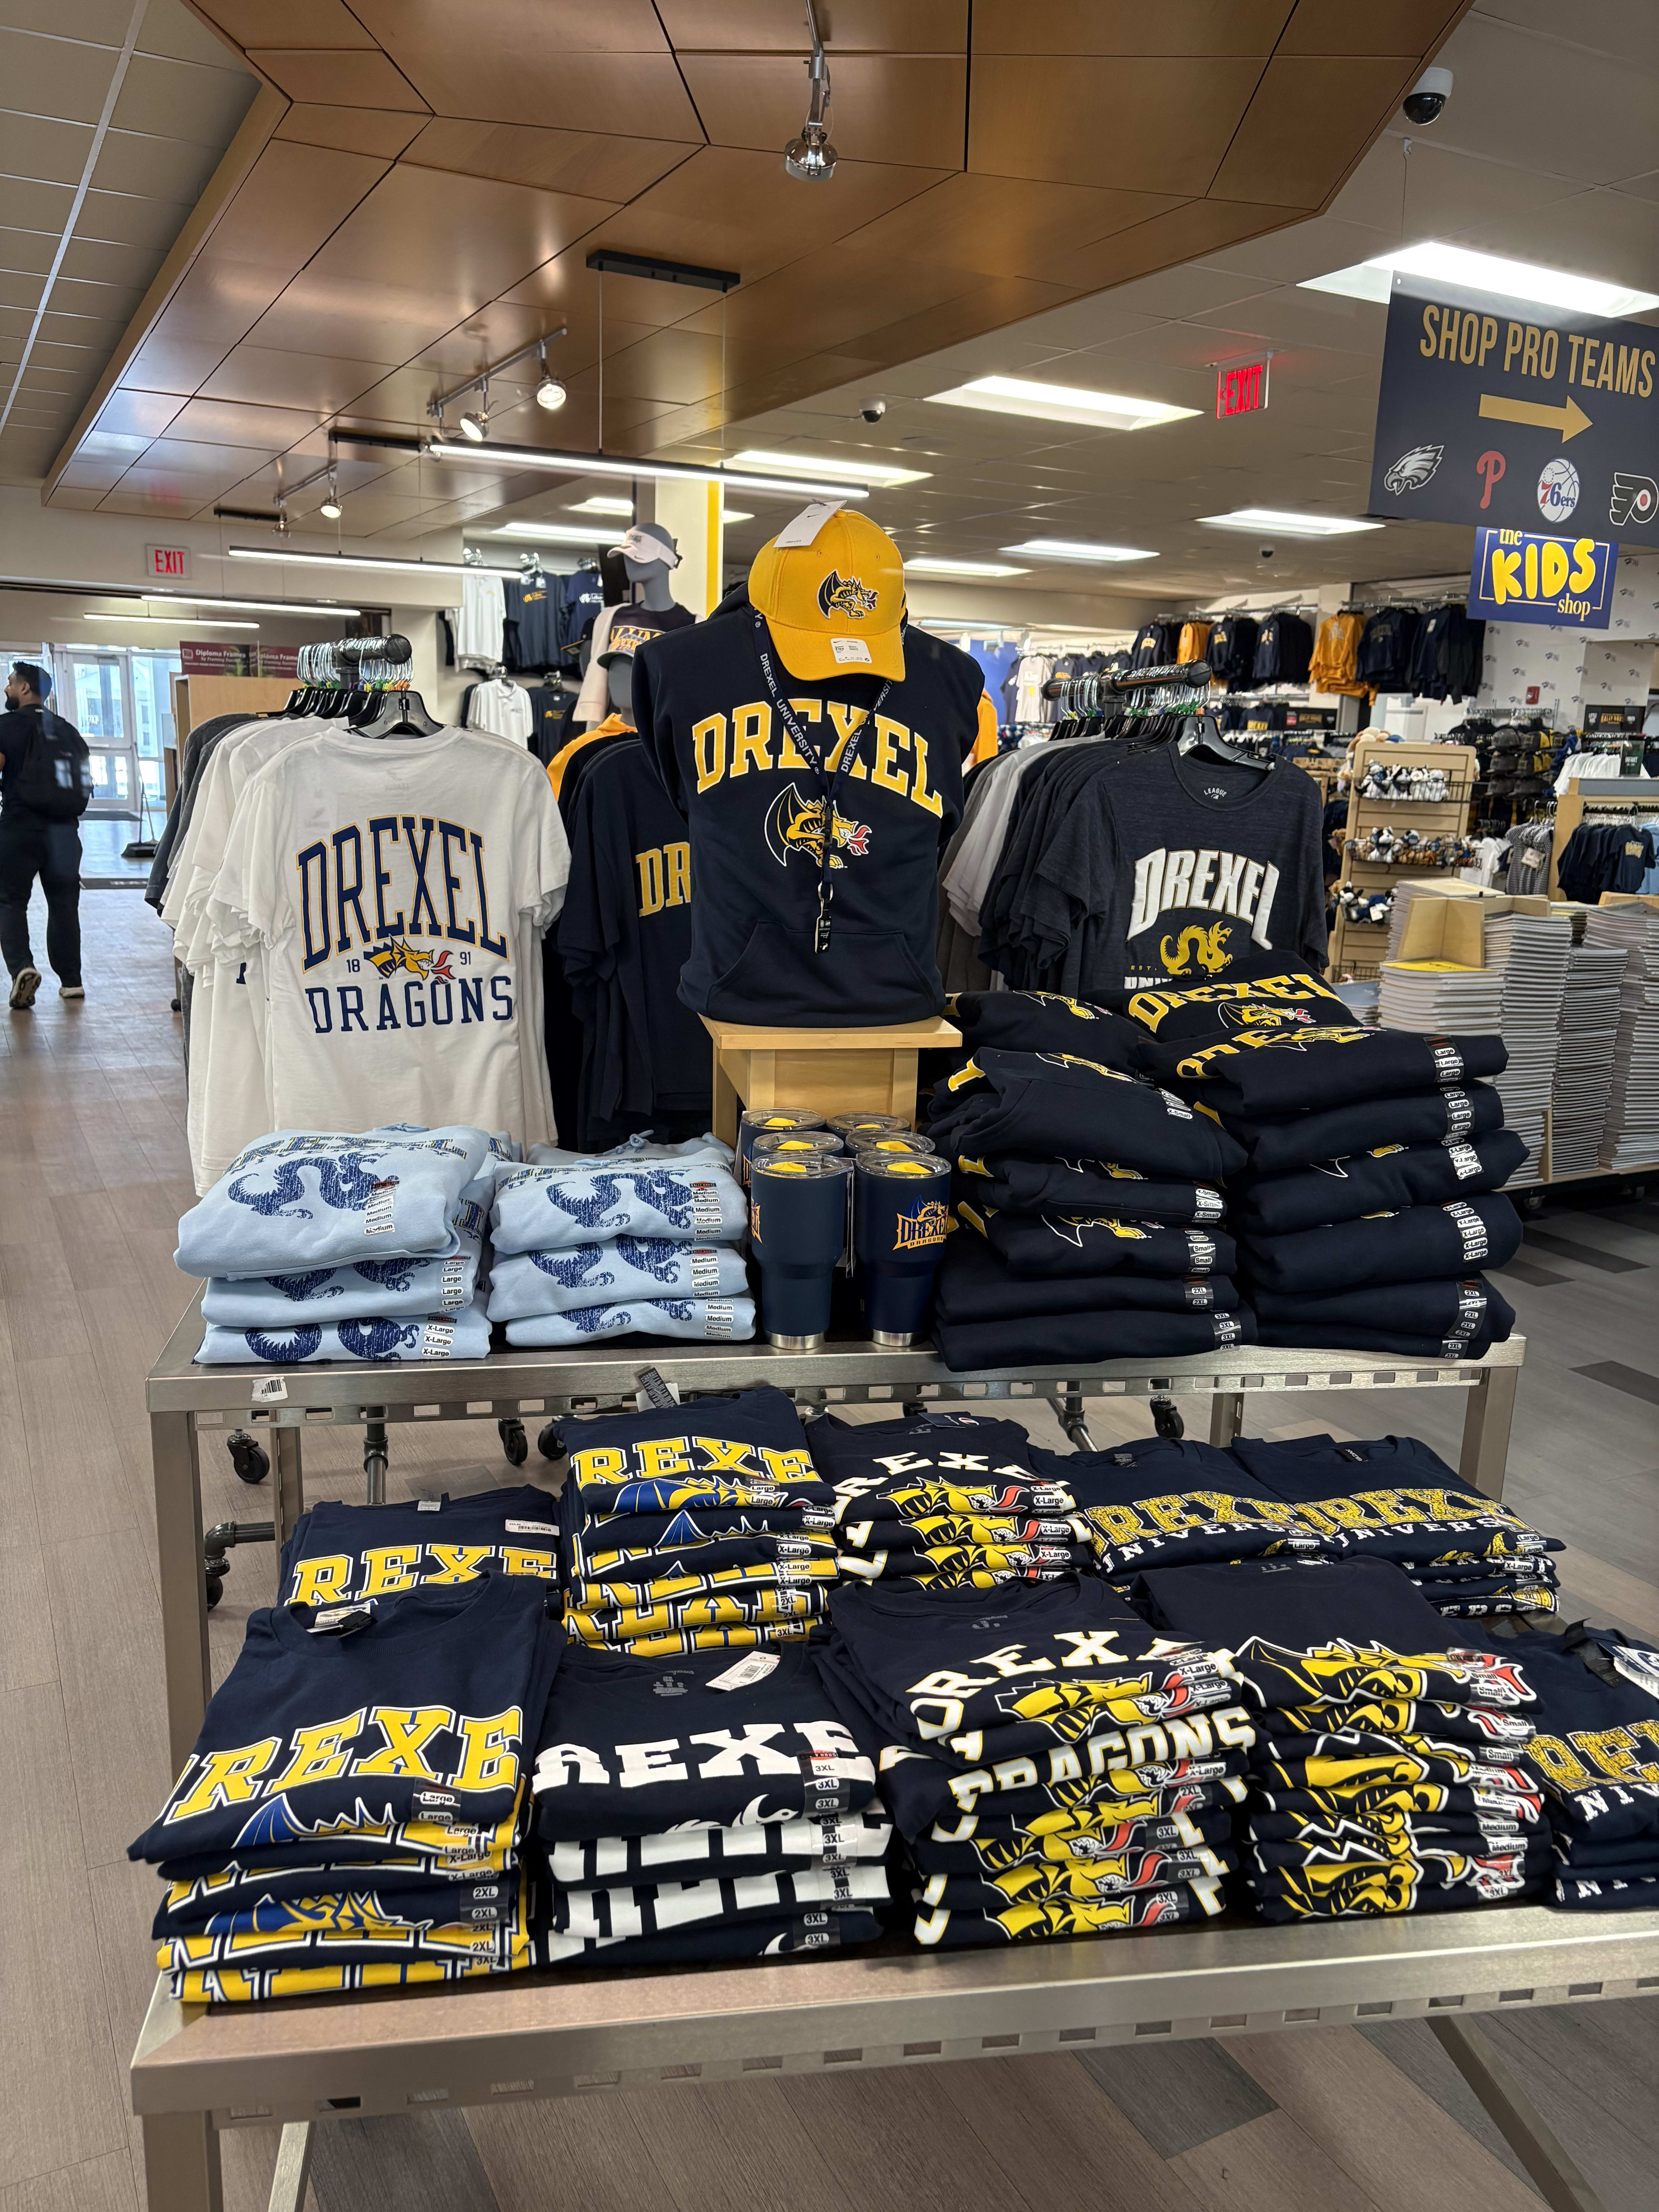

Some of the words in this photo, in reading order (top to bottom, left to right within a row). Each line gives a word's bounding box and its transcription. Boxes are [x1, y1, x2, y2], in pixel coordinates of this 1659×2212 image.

[1420, 305, 1498, 367] SHOP
[1504, 322, 1559, 380] PRO
[1568, 335, 1656, 398] TEAMS
[1225, 365, 1262, 416] EXIT
[1539, 482, 1575, 508] 76ers
[1500, 528, 1522, 546] the
[154, 549, 185, 575] EXIT
[1491, 538, 1596, 605] KIDS
[1557, 593, 1591, 621] shop
[196, 649, 222, 657] Diploma
[760, 654, 777, 697] DREXEL
[776, 699, 817, 764] UNIVERSITY
[840, 729, 862, 773] DREXEL
[692, 698, 943, 818] DREXEL
[297, 814, 510, 974] DREXEL
[1125, 847, 1280, 950] DREXEL
[347, 959, 361, 973] 18
[460, 951, 471, 965] 91
[305, 976, 512, 1033] DRAGONS
[1128, 974, 1343, 1034] DREXEL
[1169, 1108, 1190, 1118] X-Small
[1450, 1145, 1471, 1154] X-Large
[367, 1206, 392, 1216] Medium
[1452, 1208, 1473, 1217] X-Large
[366, 1214, 392, 1224] Medium
[1459, 1217, 1480, 1225] X-Large
[1463, 1227, 1484, 1237] X-Large
[1465, 1239, 1487, 1249] X-Large
[1465, 1250, 1487, 1259] X-Large
[428, 1325, 454, 1333] X-Large
[425, 1336, 452, 1344] X-Large
[423, 1348, 449, 1357] X-Large
[751, 1496, 773, 1506] Large
[804, 1506, 833, 1514] X-Large
[805, 1516, 833, 1527] X-Large
[779, 1545, 809, 1554] X-Large
[1506, 1562, 1532, 1571] X-Large
[780, 1576, 811, 1585] X-Large
[781, 1595, 796, 1606] 2XL
[778, 1627, 792, 1637] 3XL
[1180, 1663, 1216, 1676] X-Large
[1191, 1680, 1226, 1692] X-Large
[1488, 1749, 1512, 1759] Small
[1189, 1765, 1224, 1776] X-Large
[1182, 1786, 1200, 1795] 2XL
[422, 1793, 453, 1804] Large
[817, 1799, 837, 1808] 3XL
[447, 1826, 477, 1836] Large
[1159, 1827, 1176, 1836] 3XL
[1482, 1823, 1516, 1831] Medium
[824, 1834, 844, 1843] 3XL
[445, 1846, 474, 1855] Large
[1492, 1842, 1526, 1851] Medium
[1179, 1851, 1197, 1860] 3XL
[830, 1869, 850, 1879] 3XL
[475, 1888, 496, 1897] 2XL
[834, 1888, 853, 1898] 3XL
[1158, 1893, 1176, 1902] 3XL
[474, 1909, 495, 1918] 2XL
[806, 1914, 826, 1924] 3XL
[807, 1934, 827, 1944] 3XL
[472, 1942, 493, 1952] 2XL
